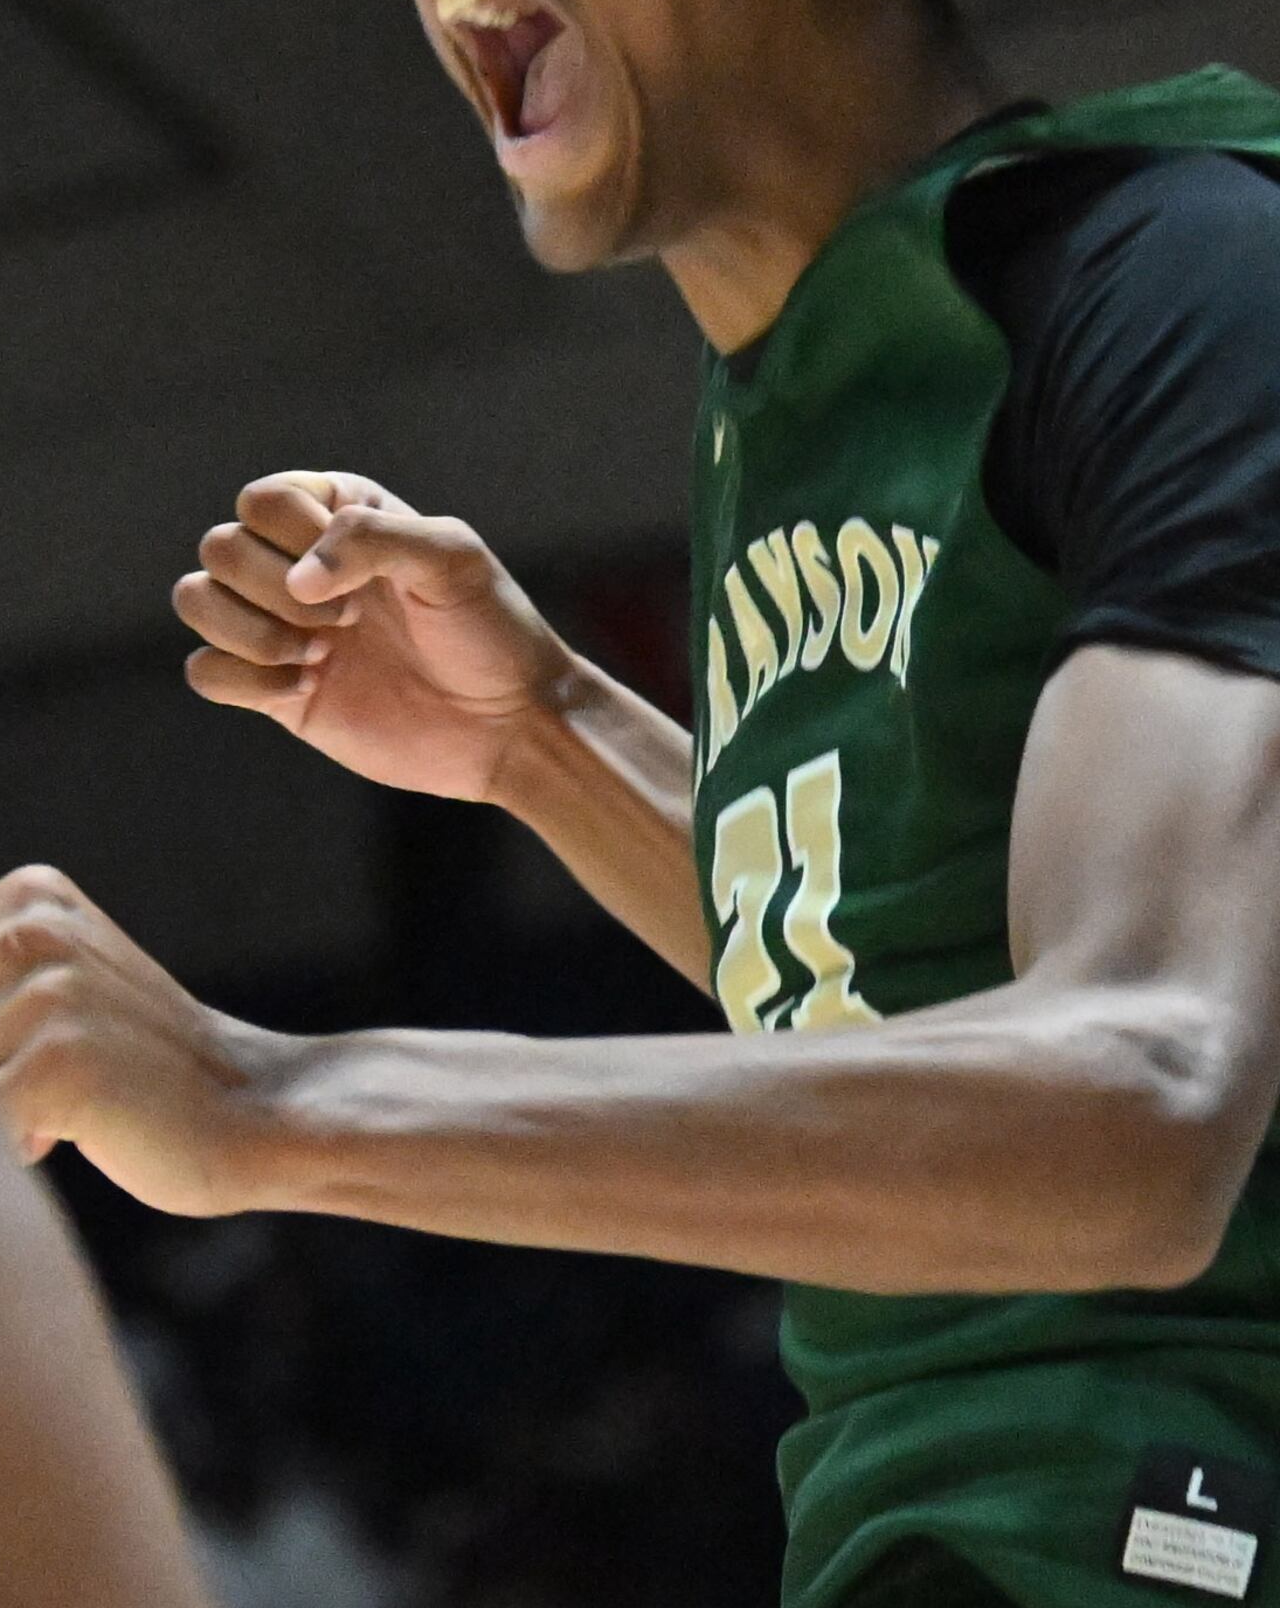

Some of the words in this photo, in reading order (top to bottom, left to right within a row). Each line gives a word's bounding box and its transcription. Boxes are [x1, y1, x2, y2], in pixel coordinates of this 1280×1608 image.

[695, 517, 939, 804] RAYSON
[712, 748, 883, 1034] 21
[1186, 1466, 1218, 1512] L
